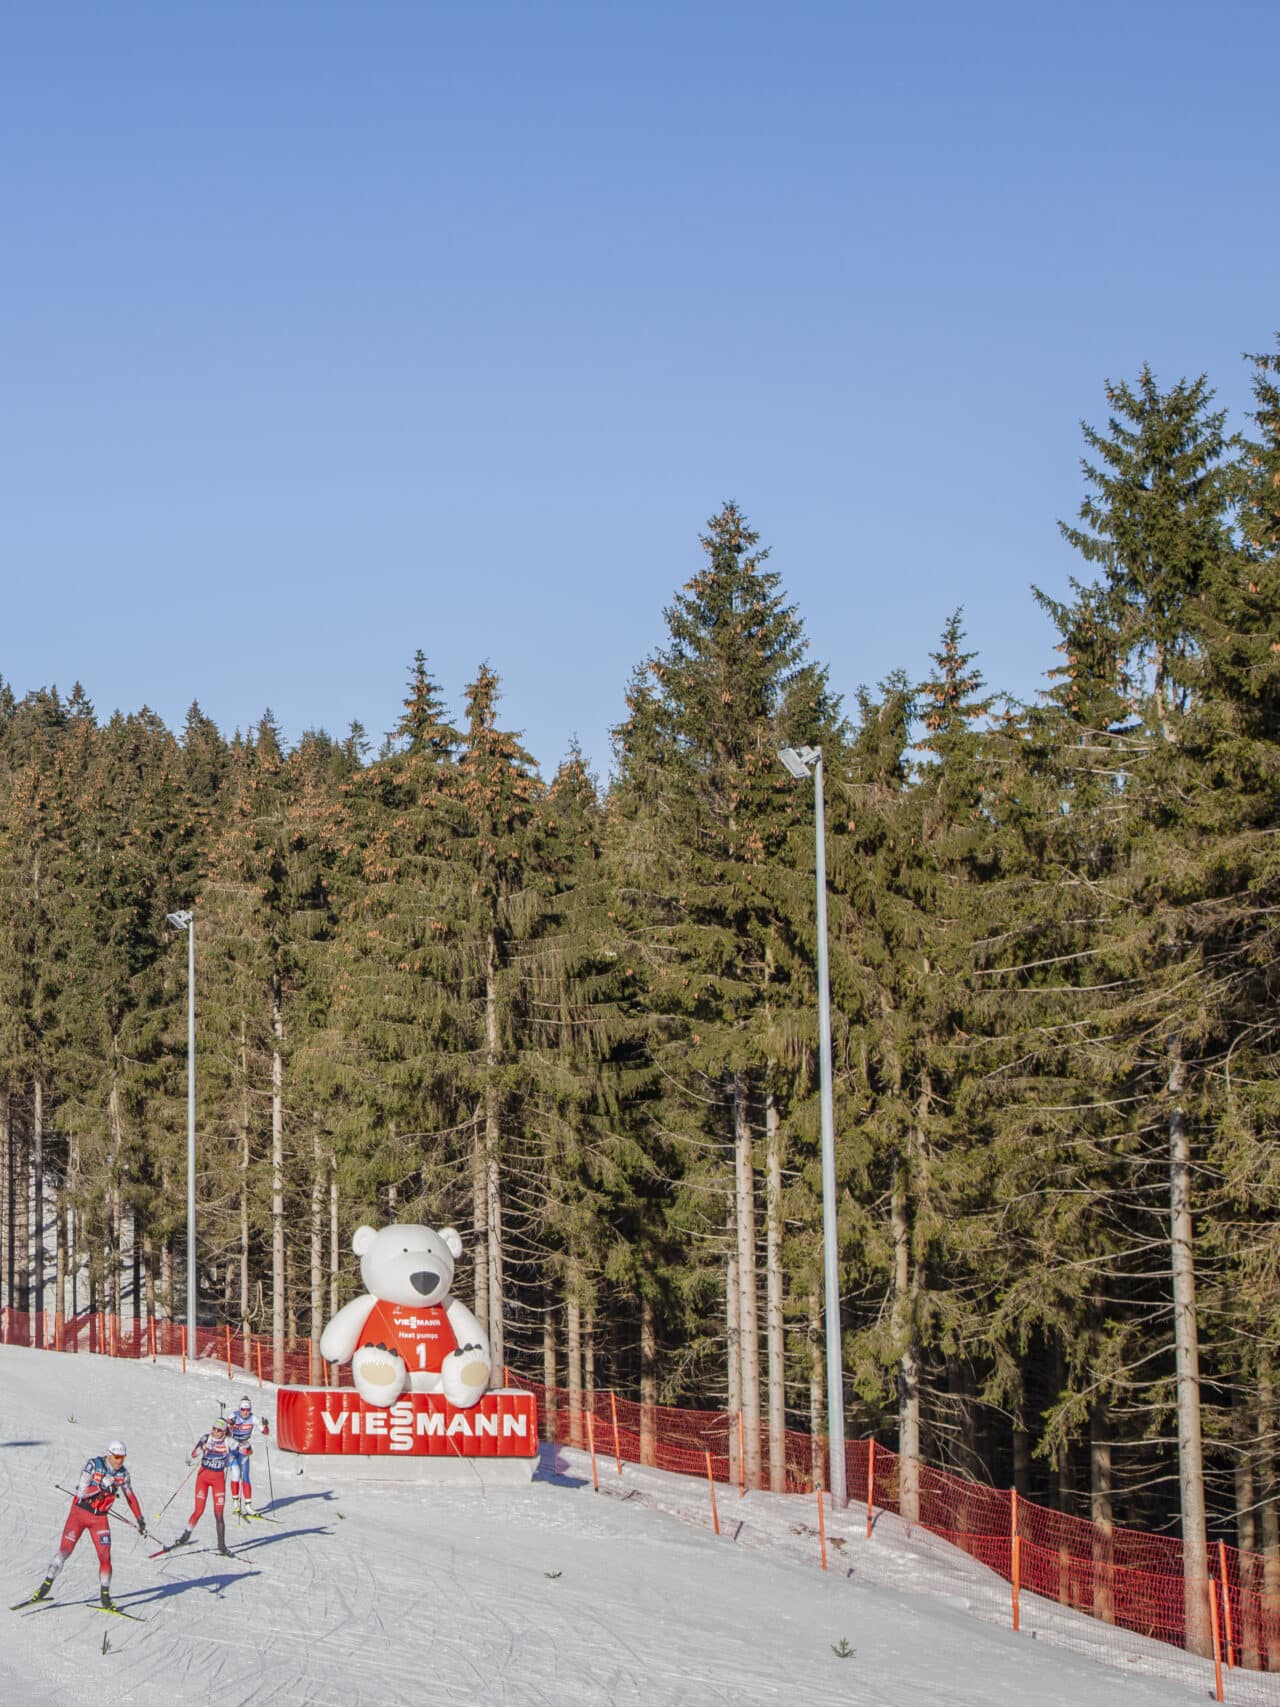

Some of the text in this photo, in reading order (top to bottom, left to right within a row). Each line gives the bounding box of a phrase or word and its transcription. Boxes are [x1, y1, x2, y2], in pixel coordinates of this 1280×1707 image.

[394, 1316, 440, 1329] VIESSMANN
[398, 1331, 439, 1340] Heat pumps
[416, 1343, 426, 1369] 1
[320, 1401, 527, 1451] VIESSMANN
